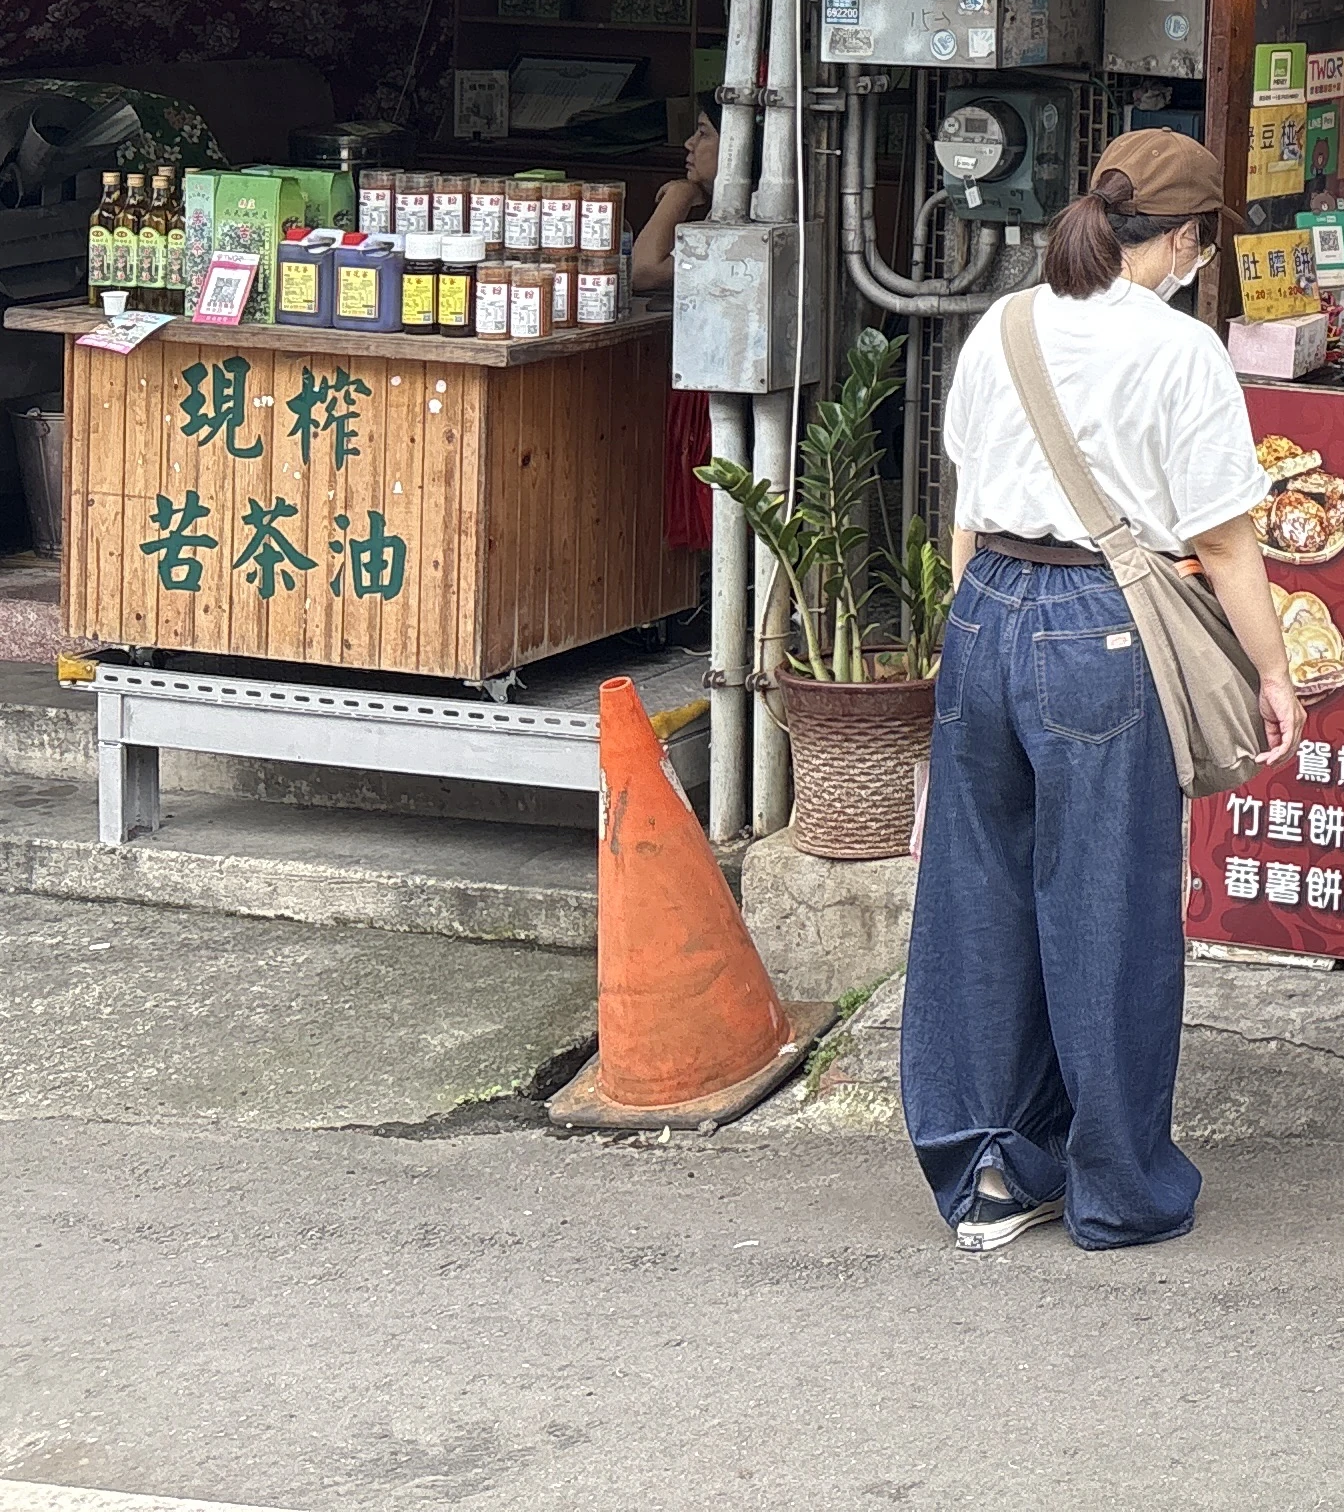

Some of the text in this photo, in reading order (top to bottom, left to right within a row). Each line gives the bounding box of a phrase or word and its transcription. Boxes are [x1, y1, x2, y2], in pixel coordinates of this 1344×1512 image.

[1309, 57, 1344, 82] TWQR
[180, 355, 373, 471] 現榨
[139, 490, 409, 602] 苦茶油
